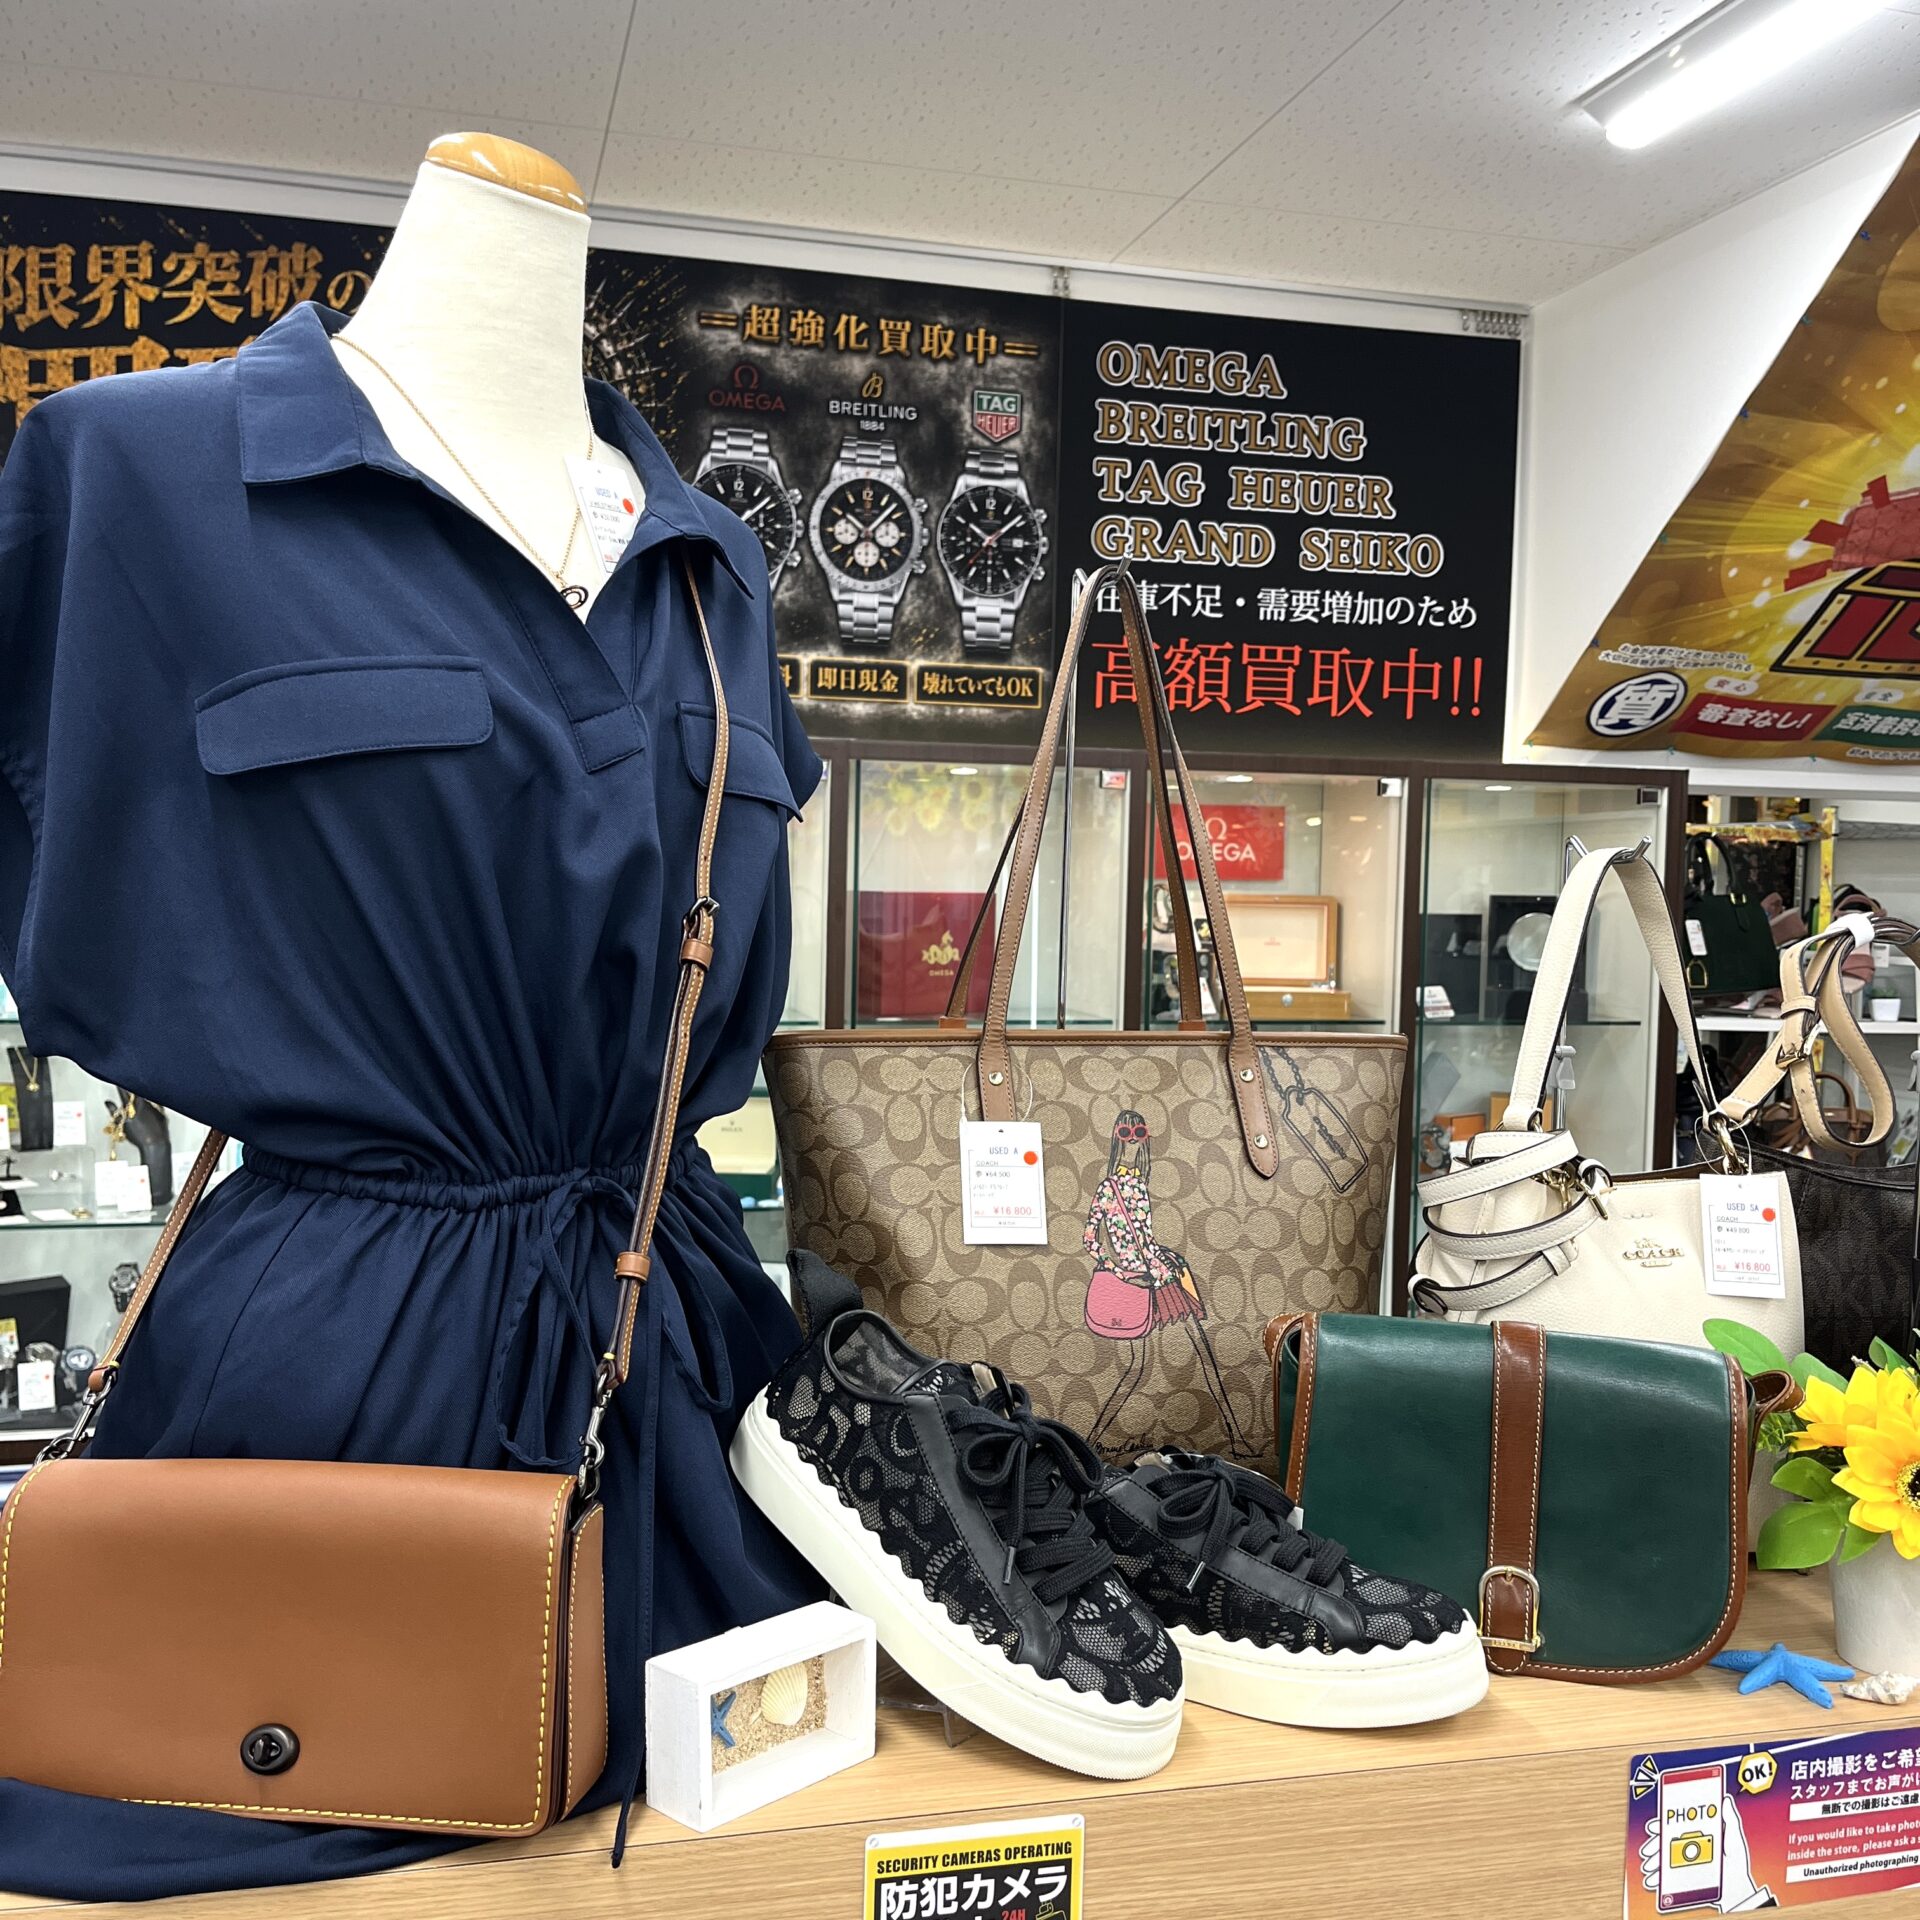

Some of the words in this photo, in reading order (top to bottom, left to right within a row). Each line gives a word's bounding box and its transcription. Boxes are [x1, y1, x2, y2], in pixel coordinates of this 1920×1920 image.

[743, 304, 998, 365] 超強化買取中
[1096, 341, 1288, 399] OMEGA
[708, 390, 787, 412] OMEGA
[829, 400, 917, 420] BREITLING
[979, 395, 1017, 412] TAG
[860, 420, 885, 432] 1884
[976, 414, 1017, 434] HEUER
[1094, 399, 1367, 461] BREITLING
[1093, 458, 1205, 507] TAG
[1228, 468, 1396, 519] HEUER
[1091, 516, 1275, 567] GRAND
[1299, 528, 1444, 577] SEIKO
[817, 667, 900, 693] 即日現金
[923, 672, 1034, 698] 壊れていてもOK
[1597, 683, 1679, 727] 質
[1177, 841, 1256, 862] OEGA
[989, 1147, 1009, 1155] USED
[1013, 1147, 1019, 1155] A
[1726, 1203, 1746, 1211] USED
[1750, 1204, 1759, 1212] SA
[1742, 1762, 1773, 1783] OK!
[1667, 1804, 1718, 1825] PHOTO
[1788, 1833, 1796, 1845] If
[1797, 1834, 1814, 1846] you
[1816, 1828, 1844, 1840] would
[1846, 1826, 1863, 1837] like
[1865, 1826, 1874, 1835] to
[1876, 1823, 1896, 1833] take
[877, 1855, 939, 1874] SECURITY
[942, 1848, 1001, 1867] CAMERAS
[1004, 1841, 1072, 1860] OPERATING
[1788, 1848, 1815, 1861] inside
[1817, 1846, 1832, 1857] the
[1834, 1844, 1860, 1855] store,
[1863, 1840, 1892, 1853] please
[1894, 1835, 1909, 1847] ask
[1803, 1861, 1858, 1877] Unauthorized
[1859, 1854, 1919, 1872] photographing
[880, 1865, 1069, 1920] 防犯カメラ
